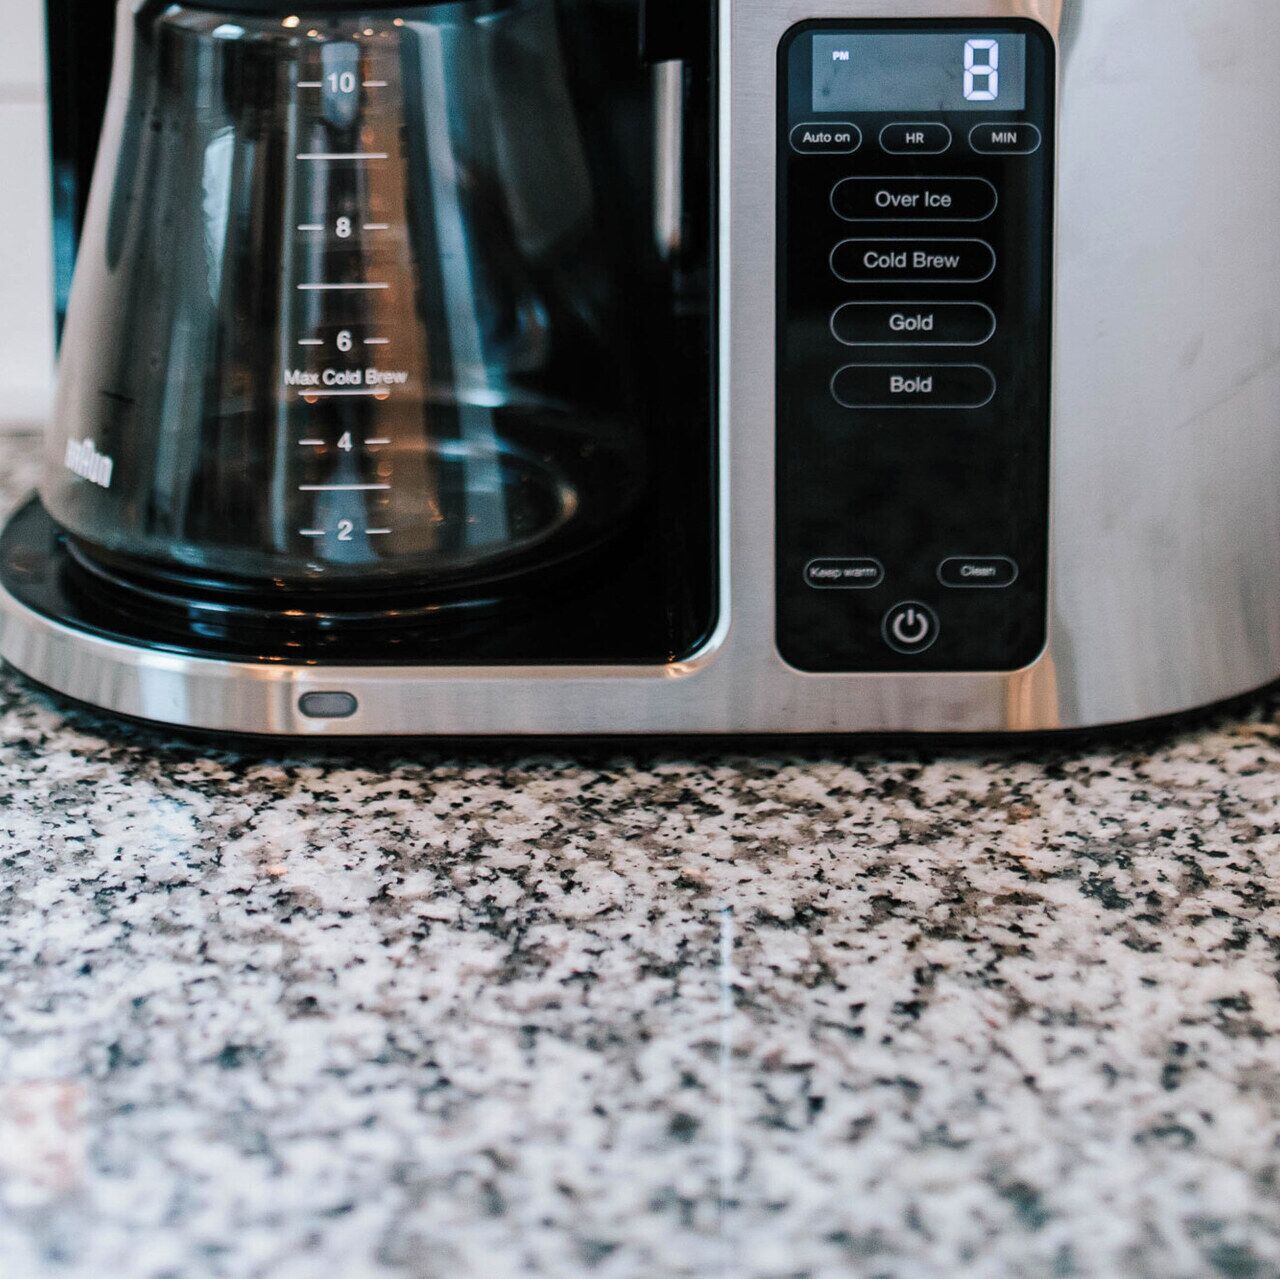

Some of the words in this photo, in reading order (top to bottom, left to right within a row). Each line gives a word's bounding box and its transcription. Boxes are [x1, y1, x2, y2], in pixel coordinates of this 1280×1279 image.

[832, 50, 850, 61] PM
[963, 39, 999, 101] 8
[326, 69, 356, 94] 10
[802, 131, 832, 143] Auto
[834, 133, 851, 143] on
[905, 131, 925, 144] HR
[991, 131, 1017, 144] MIN
[875, 190, 920, 208] Over
[924, 190, 952, 208] Ice
[335, 216, 352, 239] 8
[863, 251, 907, 269] Cold
[912, 251, 960, 269] Brew
[888, 313, 934, 331] Gold
[336, 330, 353, 352] 6
[283, 368, 320, 387] Max
[321, 368, 362, 386] Cold
[365, 367, 408, 386] Brew
[890, 375, 933, 393] Bold
[336, 431, 353, 452] 4
[337, 519, 354, 541] 2
[809, 566, 842, 580] Keep
[843, 567, 877, 578] warm
[960, 565, 996, 577] Clean
